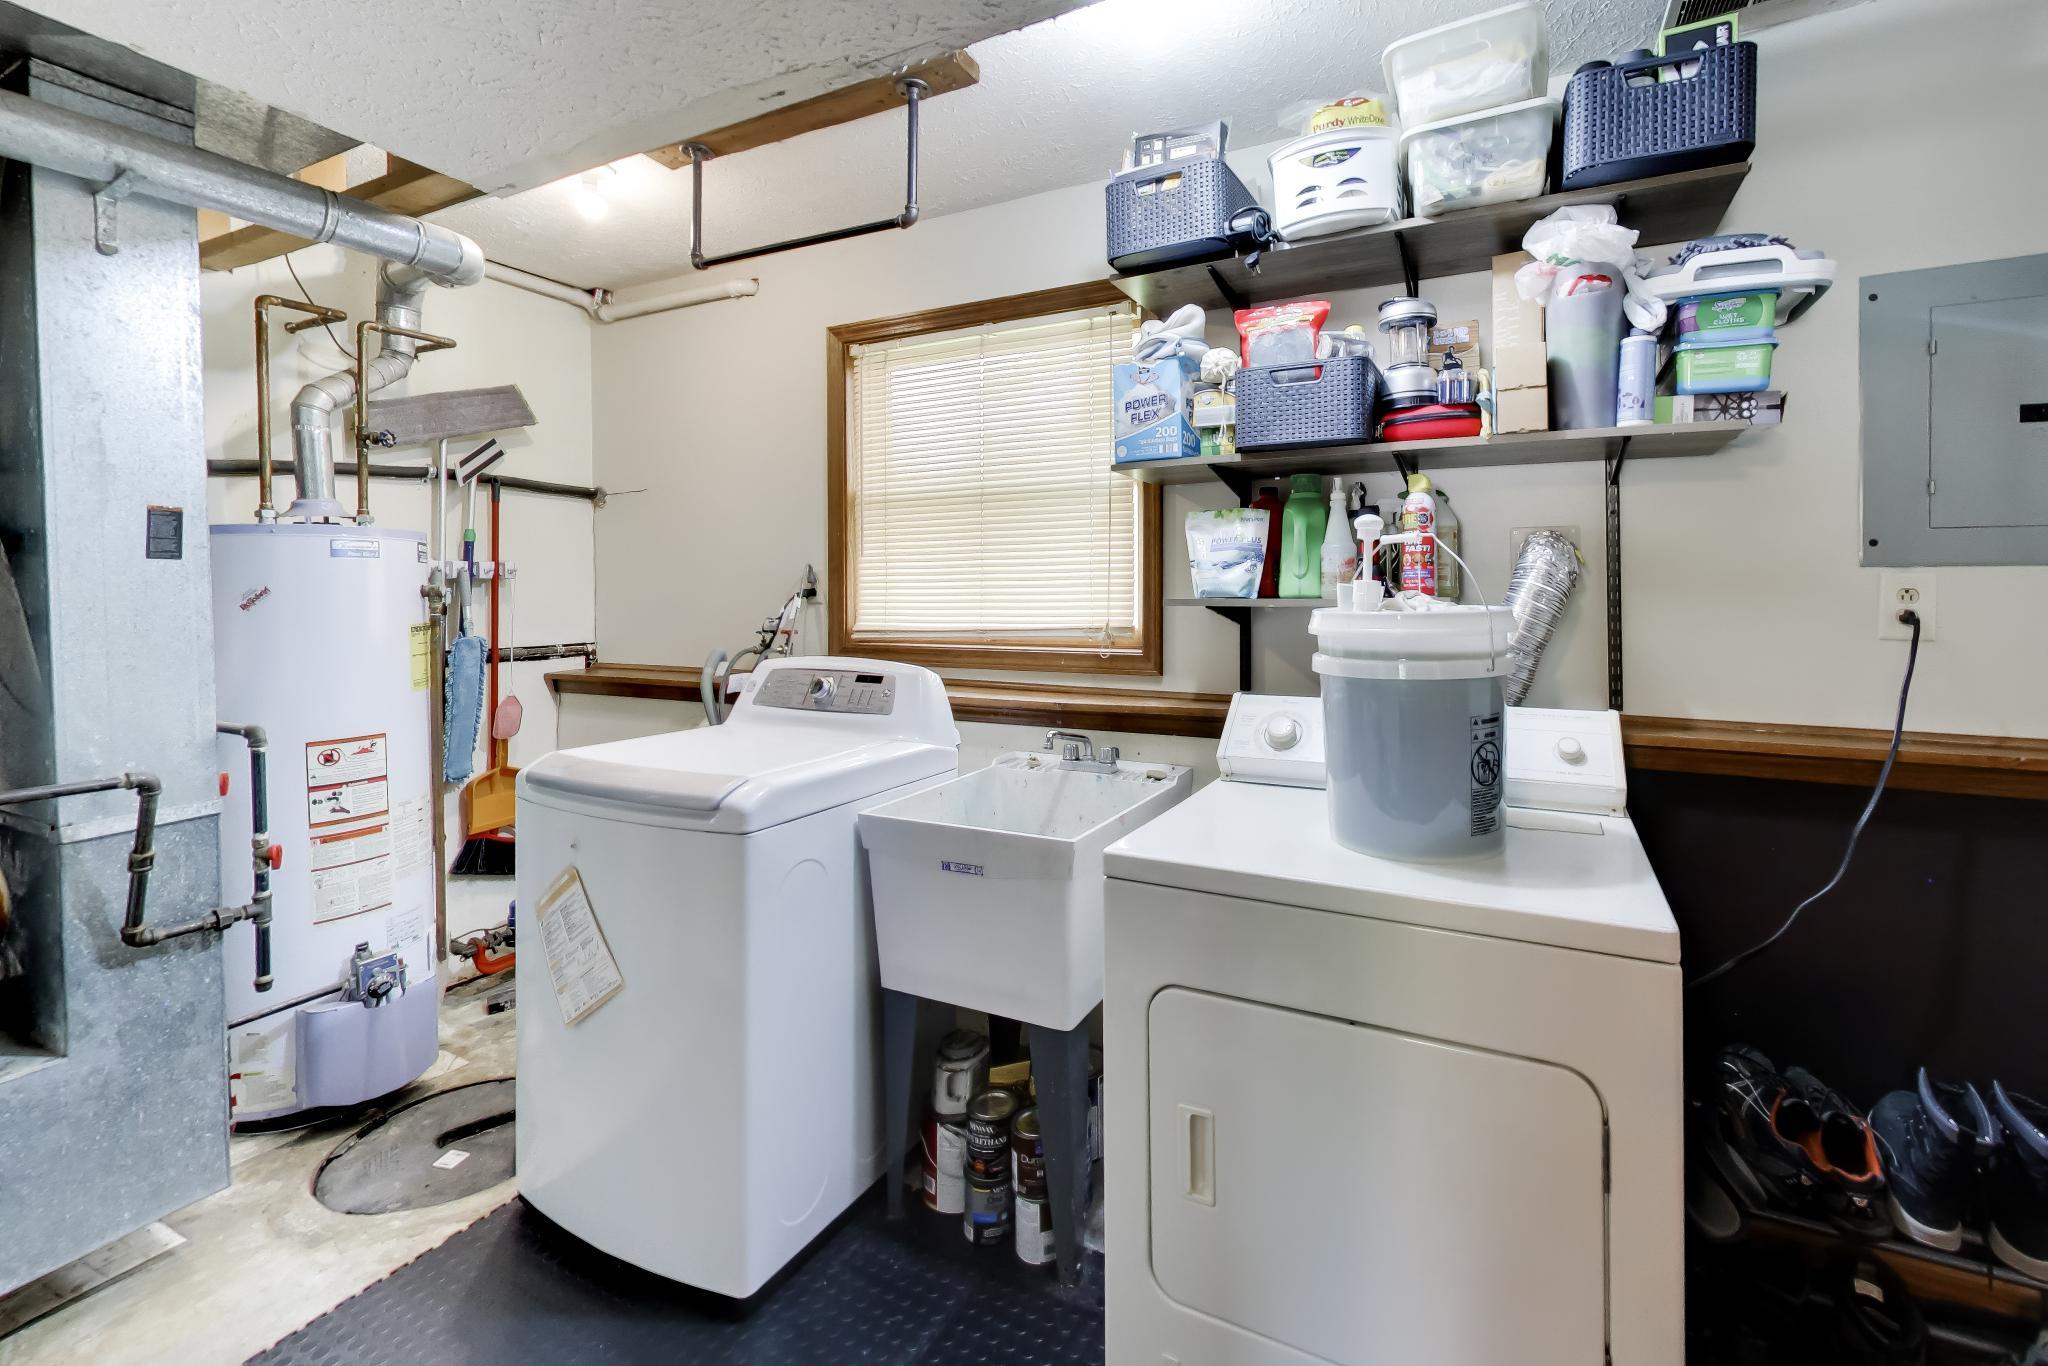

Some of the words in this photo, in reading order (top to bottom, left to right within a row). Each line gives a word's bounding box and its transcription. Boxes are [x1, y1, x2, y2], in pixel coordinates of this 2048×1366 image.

[1313, 118, 1345, 133] Purdy
[1125, 394, 1167, 413] POWER
[1131, 408, 1159, 424] FLEX
[1155, 425, 1178, 438] 200
[1183, 431, 1196, 448] 200
